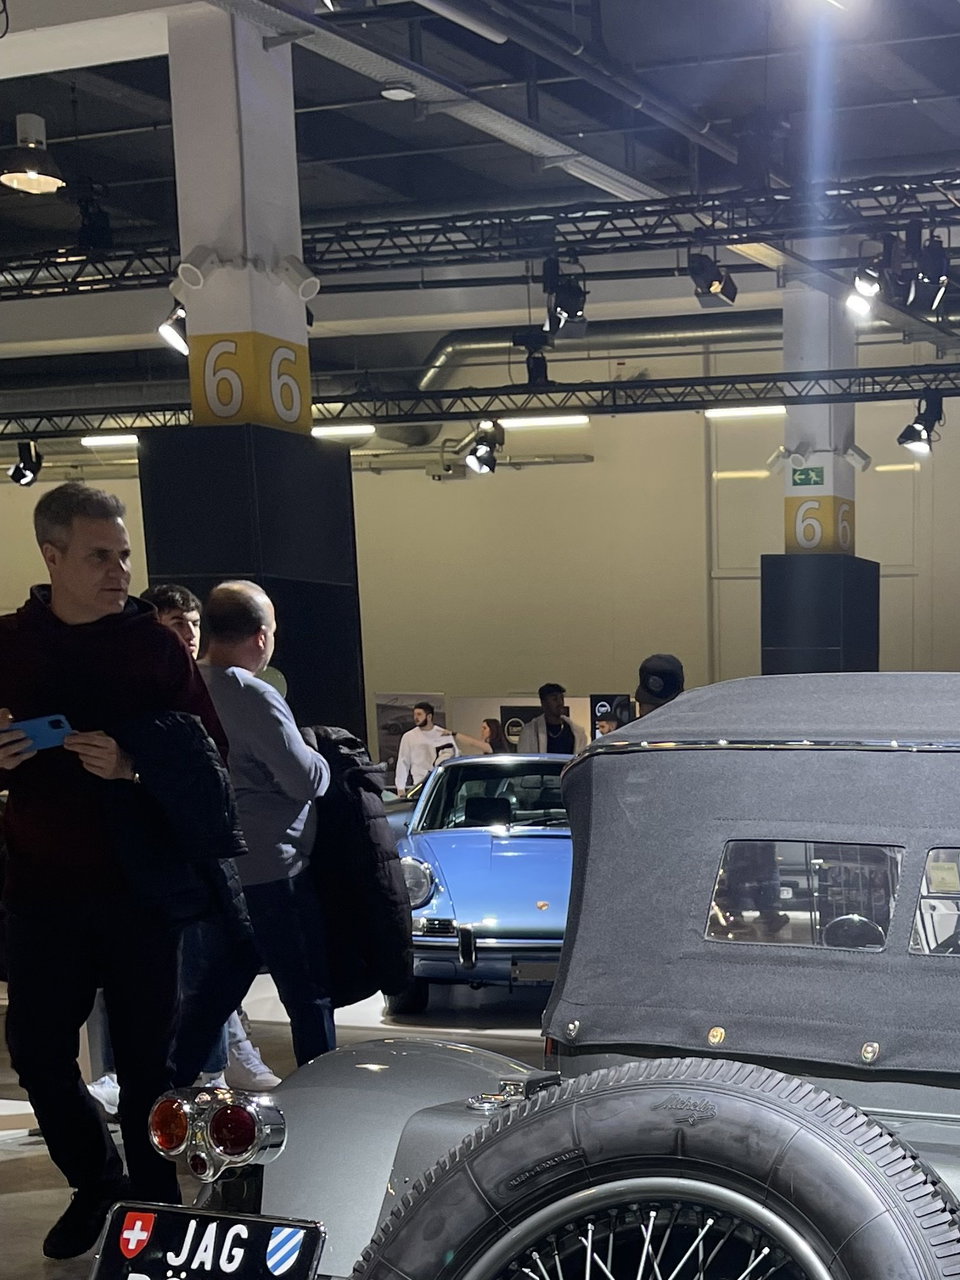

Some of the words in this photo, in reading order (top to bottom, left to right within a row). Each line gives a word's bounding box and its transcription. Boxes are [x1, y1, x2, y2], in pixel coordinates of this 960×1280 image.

[203, 339, 244, 419] 6
[270, 345, 303, 424] 6
[795, 499, 823, 550] 6
[837, 502, 851, 551] 6
[166, 1218, 249, 1274] JAG
